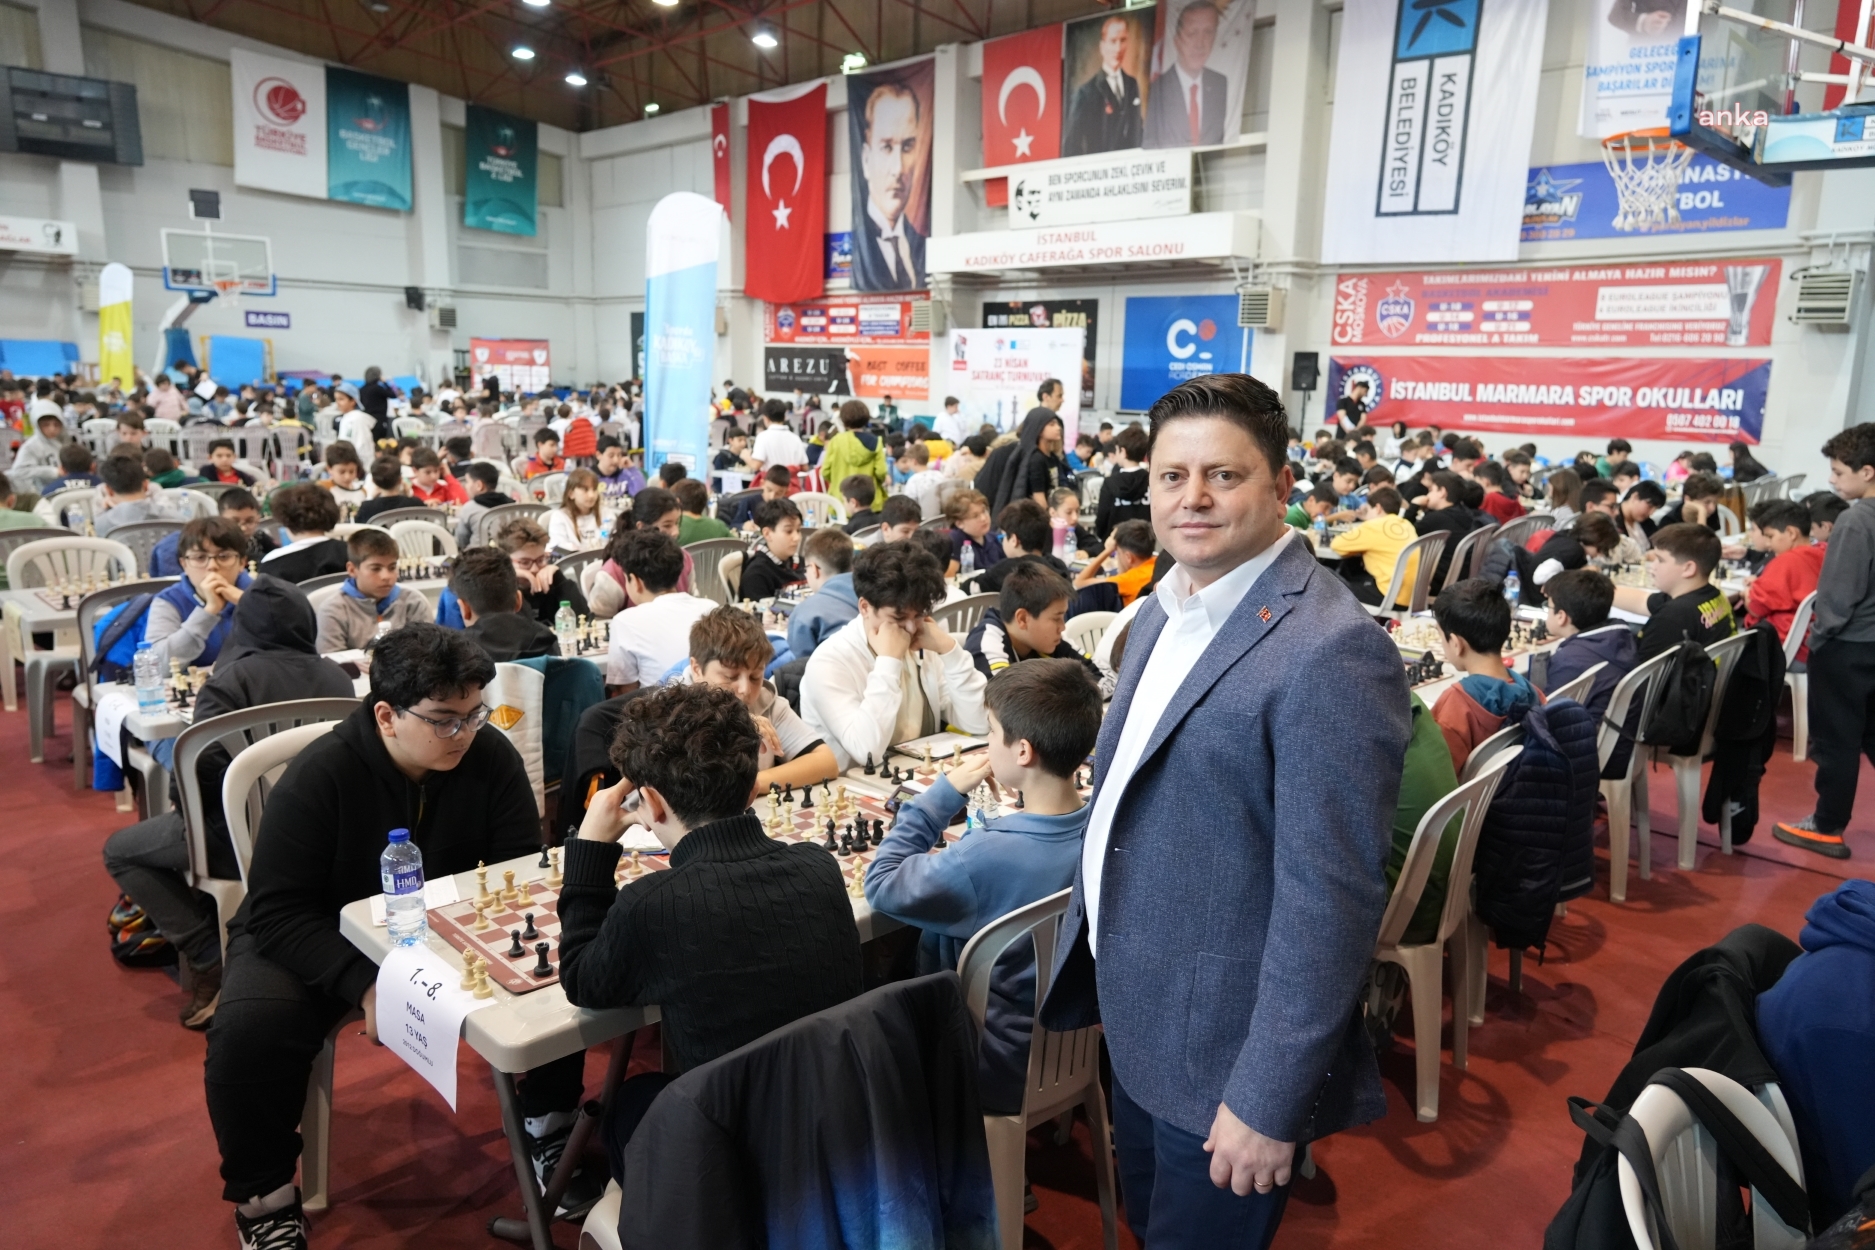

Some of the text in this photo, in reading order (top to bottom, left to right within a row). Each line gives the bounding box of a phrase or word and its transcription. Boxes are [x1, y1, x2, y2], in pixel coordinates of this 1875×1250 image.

[1586, 59, 1641, 78] ŞAMPİYON
[1597, 77, 1659, 93] BAŞARILAR
[1432, 72, 1457, 167] KADIKÖY
[255, 125, 306, 142] TÜRKİYE
[338, 128, 396, 149] BASKETBOL
[1389, 77, 1417, 198] BELEDİYESİ
[1048, 174, 1062, 186] BEN
[1064, 169, 1109, 185] SPORCUNUN
[1130, 163, 1155, 181] ÇEVİK
[1156, 161, 1166, 174] VE
[1048, 190, 1064, 203] AYNI
[1065, 187, 1101, 201] ZAMANDA
[1102, 182, 1149, 198] AHLAKLISINI
[1037, 230, 1097, 246] İSTANBUL
[965, 243, 1185, 267] KADIKÖY CAFERAĞA SPOR SALONU
[1423, 266, 1718, 285] TAKIMLARIMIZDAKİ YERİNİ ALMAYA HAZIR MISIN?
[1608, 293, 1669, 302] EUROLEAGUE
[1334, 277, 1358, 343] CSKA
[1352, 277, 1369, 343] MOSKOVA
[1381, 303, 1410, 316] CSKA
[1606, 305, 1666, 314] EUROLEAGUE
[248, 313, 289, 328] BASIN
[1415, 332, 1540, 344] PROFESYONEL A TAKIM
[766, 357, 830, 375] AREZU
[895, 361, 926, 372] COFFEE
[1004, 355, 1029, 369] NİSAN
[860, 374, 878, 386] FOR
[972, 370, 1005, 383] SATRANÇ
[1390, 378, 1744, 411] İSTANBUL MARMARA SPOR OKULLARI
[1666, 413, 1691, 426] 0507
[1692, 414, 1712, 428] 402
[1713, 415, 1726, 429] 00
[396, 876, 417, 889] HMD
[406, 1001, 426, 1025] MASA
[405, 1023, 428, 1050] 13 YAŞ
